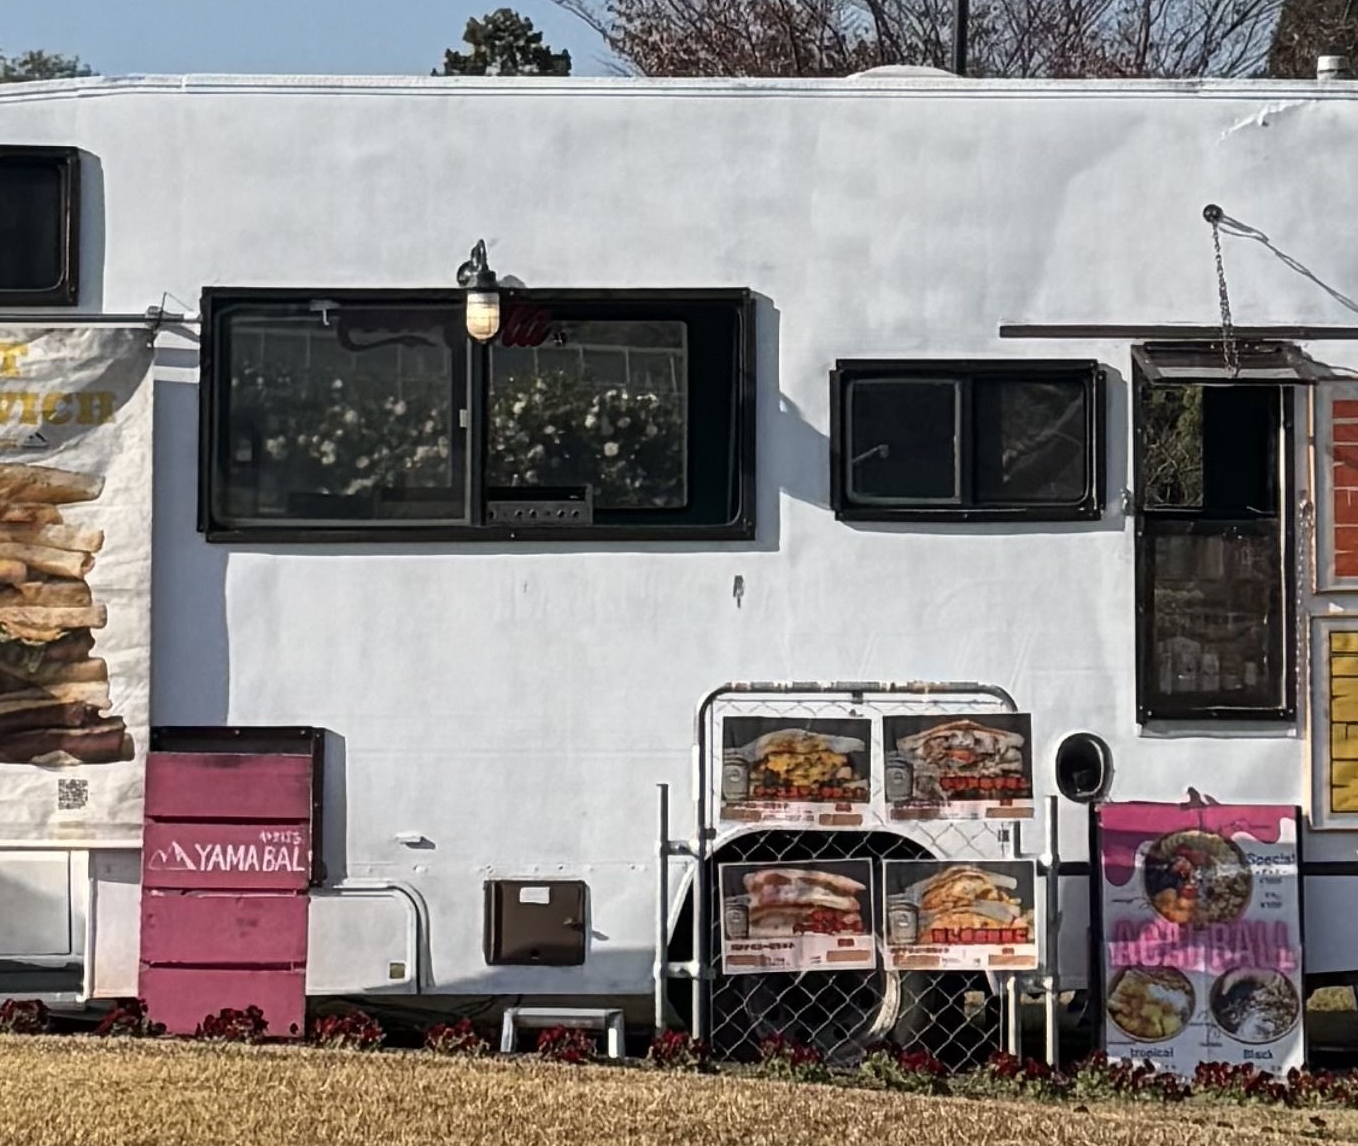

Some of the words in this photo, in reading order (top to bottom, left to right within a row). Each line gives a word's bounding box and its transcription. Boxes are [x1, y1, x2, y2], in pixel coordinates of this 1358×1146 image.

[194, 843, 260, 872] YAMA
[262, 844, 306, 872] BAL
[1247, 853, 1296, 866] Special
[1207, 920, 1299, 974] BALL
